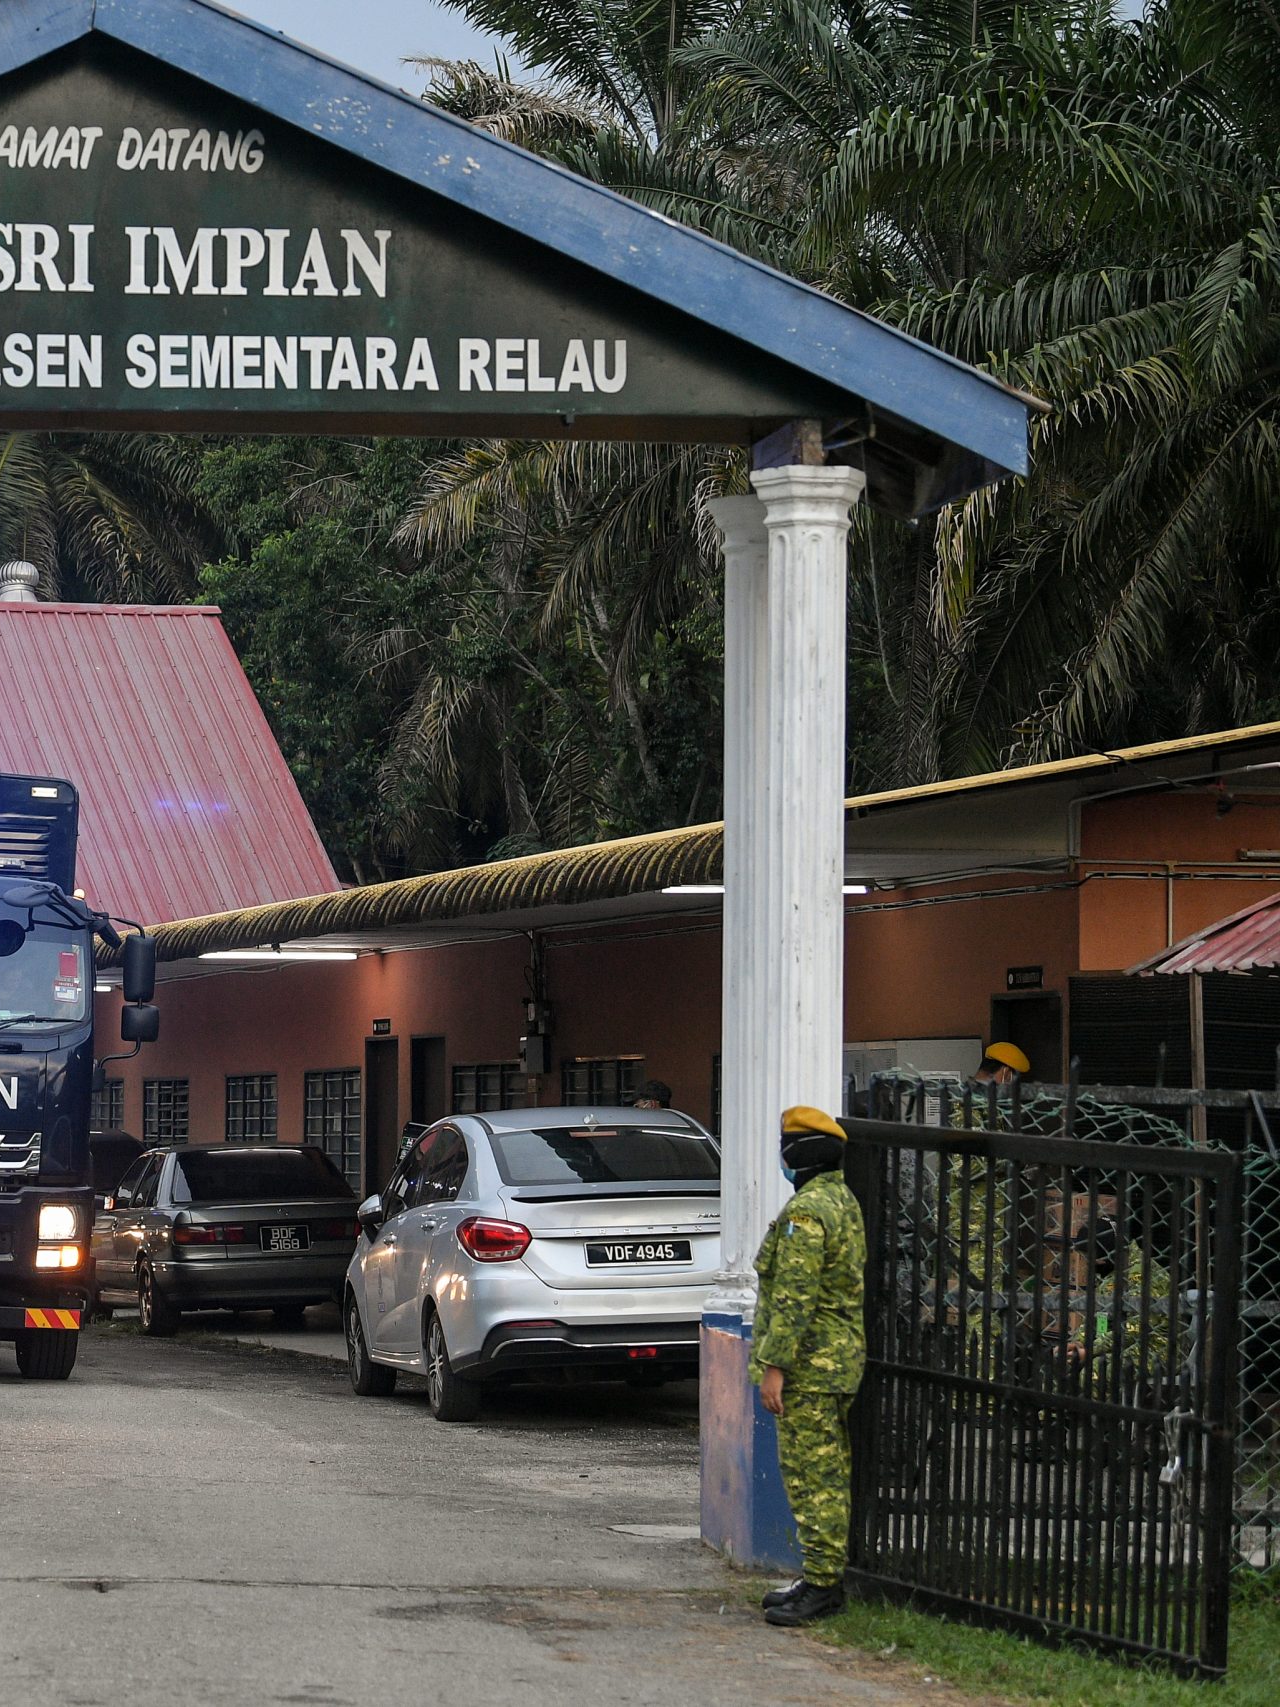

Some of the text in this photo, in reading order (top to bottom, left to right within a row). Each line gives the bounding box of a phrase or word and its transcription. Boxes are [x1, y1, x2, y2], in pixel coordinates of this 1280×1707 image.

[117, 127, 265, 174] DATANG
[124, 226, 391, 297] IMPIAN
[125, 334, 439, 391] SEMENTARA
[459, 338, 627, 392] RELAU
[270, 1239, 300, 1250] 5168
[271, 1228, 296, 1239] BDF
[604, 1244, 675, 1260] VDF 4945
